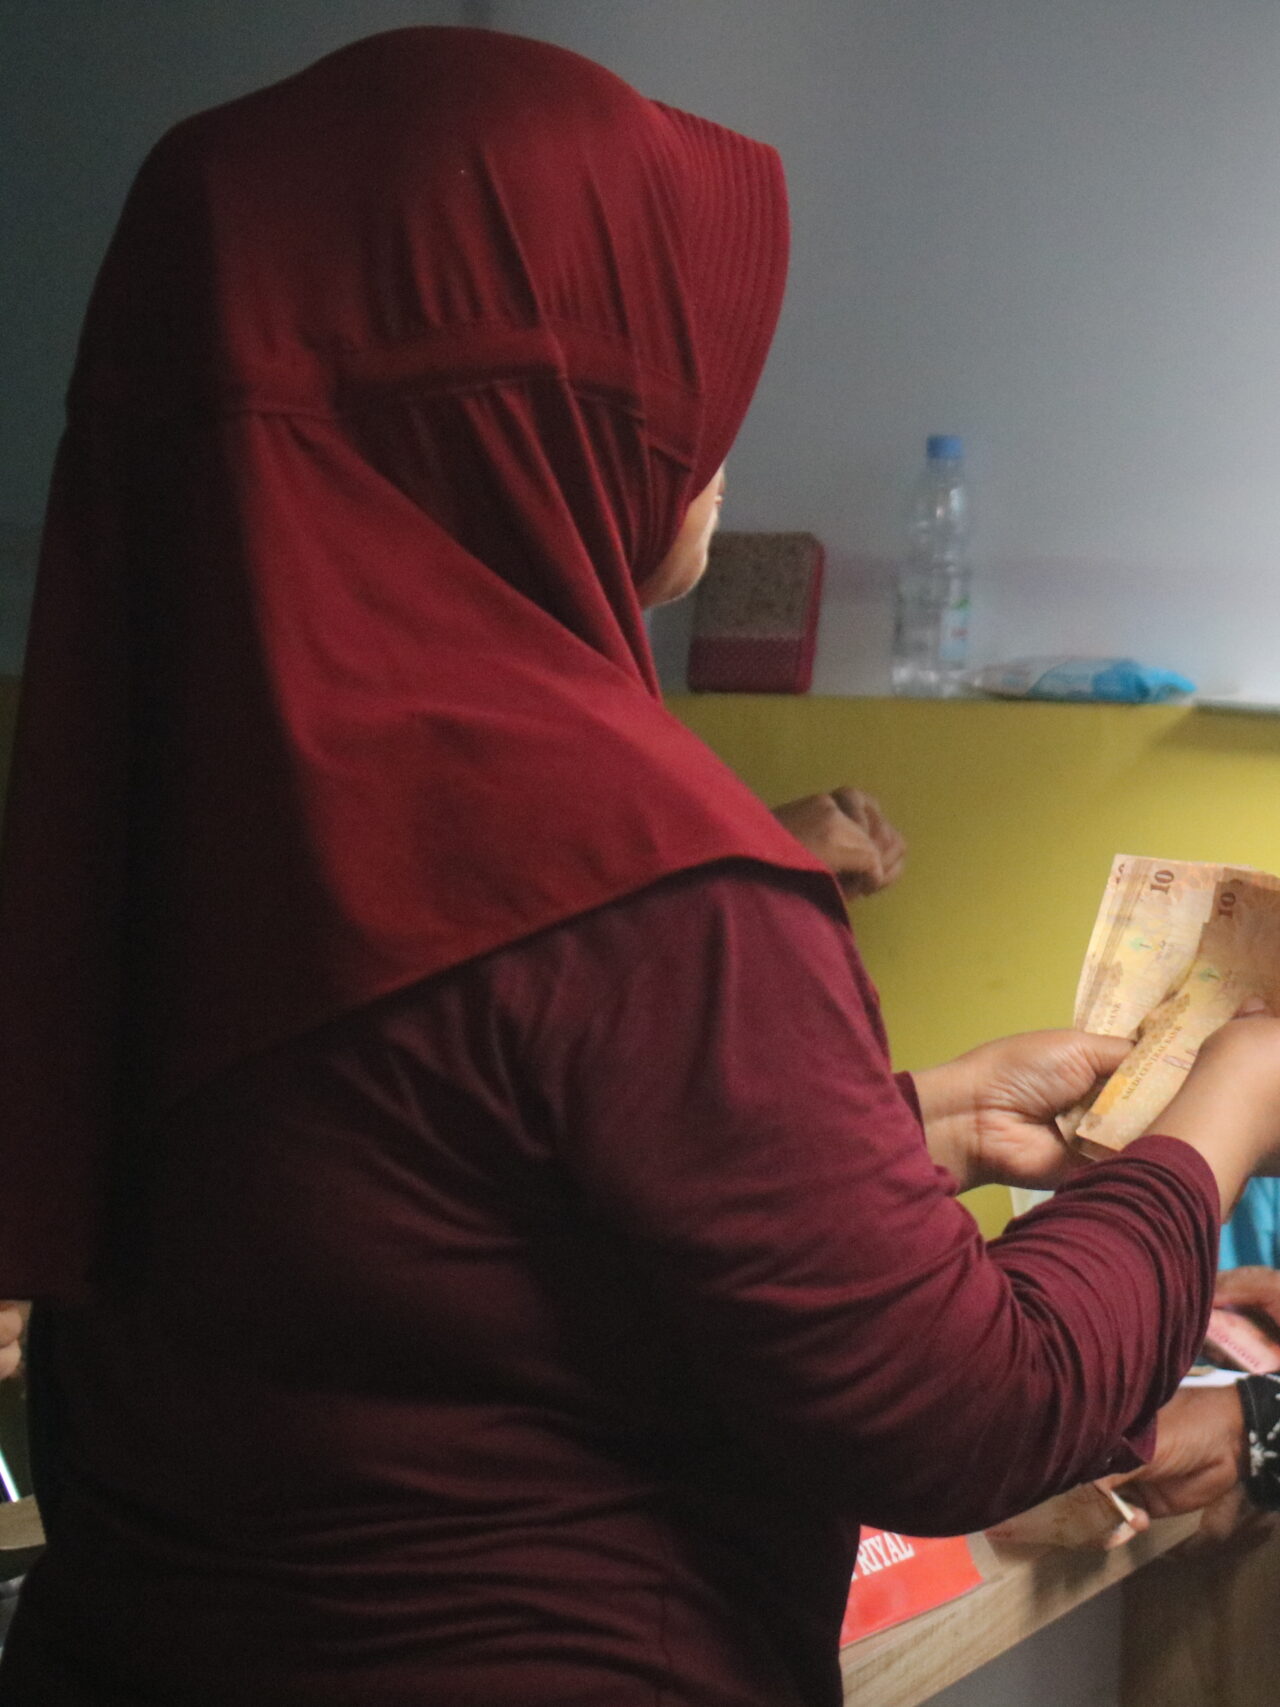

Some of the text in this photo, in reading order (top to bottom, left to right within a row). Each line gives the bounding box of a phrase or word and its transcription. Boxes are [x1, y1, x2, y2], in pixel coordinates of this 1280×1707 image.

[1150, 869, 1175, 895] 10
[1217, 892, 1236, 920] 10
[857, 1531, 915, 1576] RIYAL
